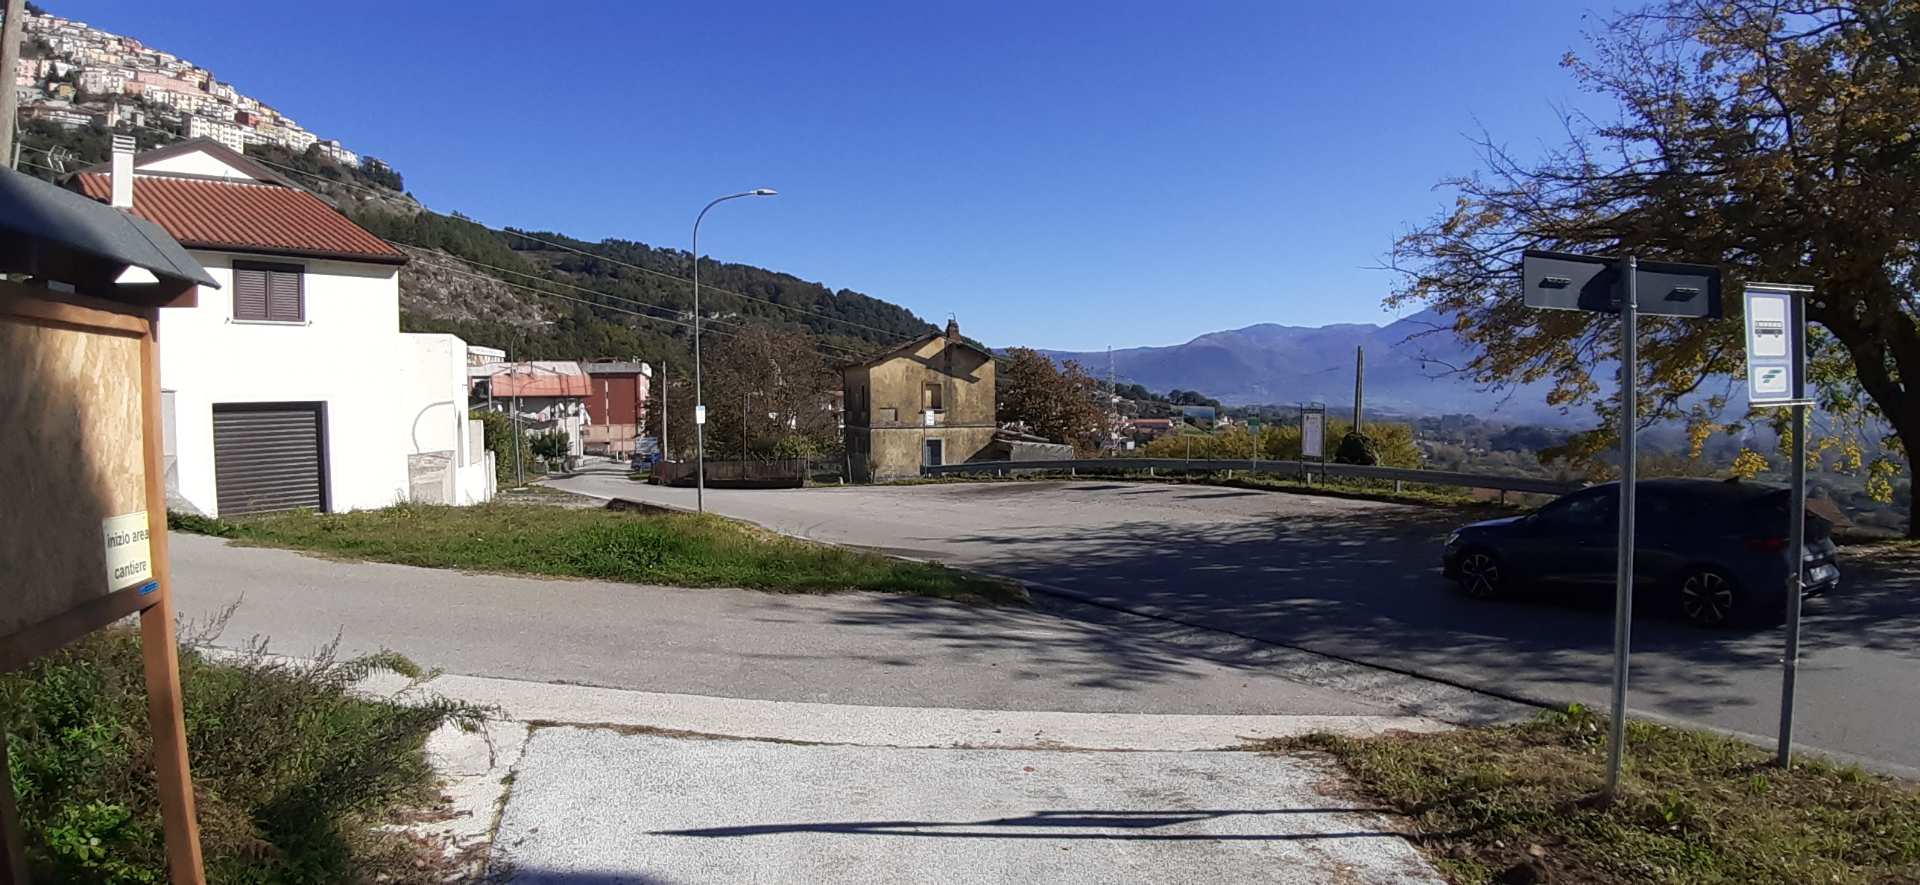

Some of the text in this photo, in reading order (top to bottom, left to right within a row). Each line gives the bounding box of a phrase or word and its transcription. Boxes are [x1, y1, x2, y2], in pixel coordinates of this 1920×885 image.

[107, 529, 149, 548] inizio area
[114, 560, 147, 579] cantiere
